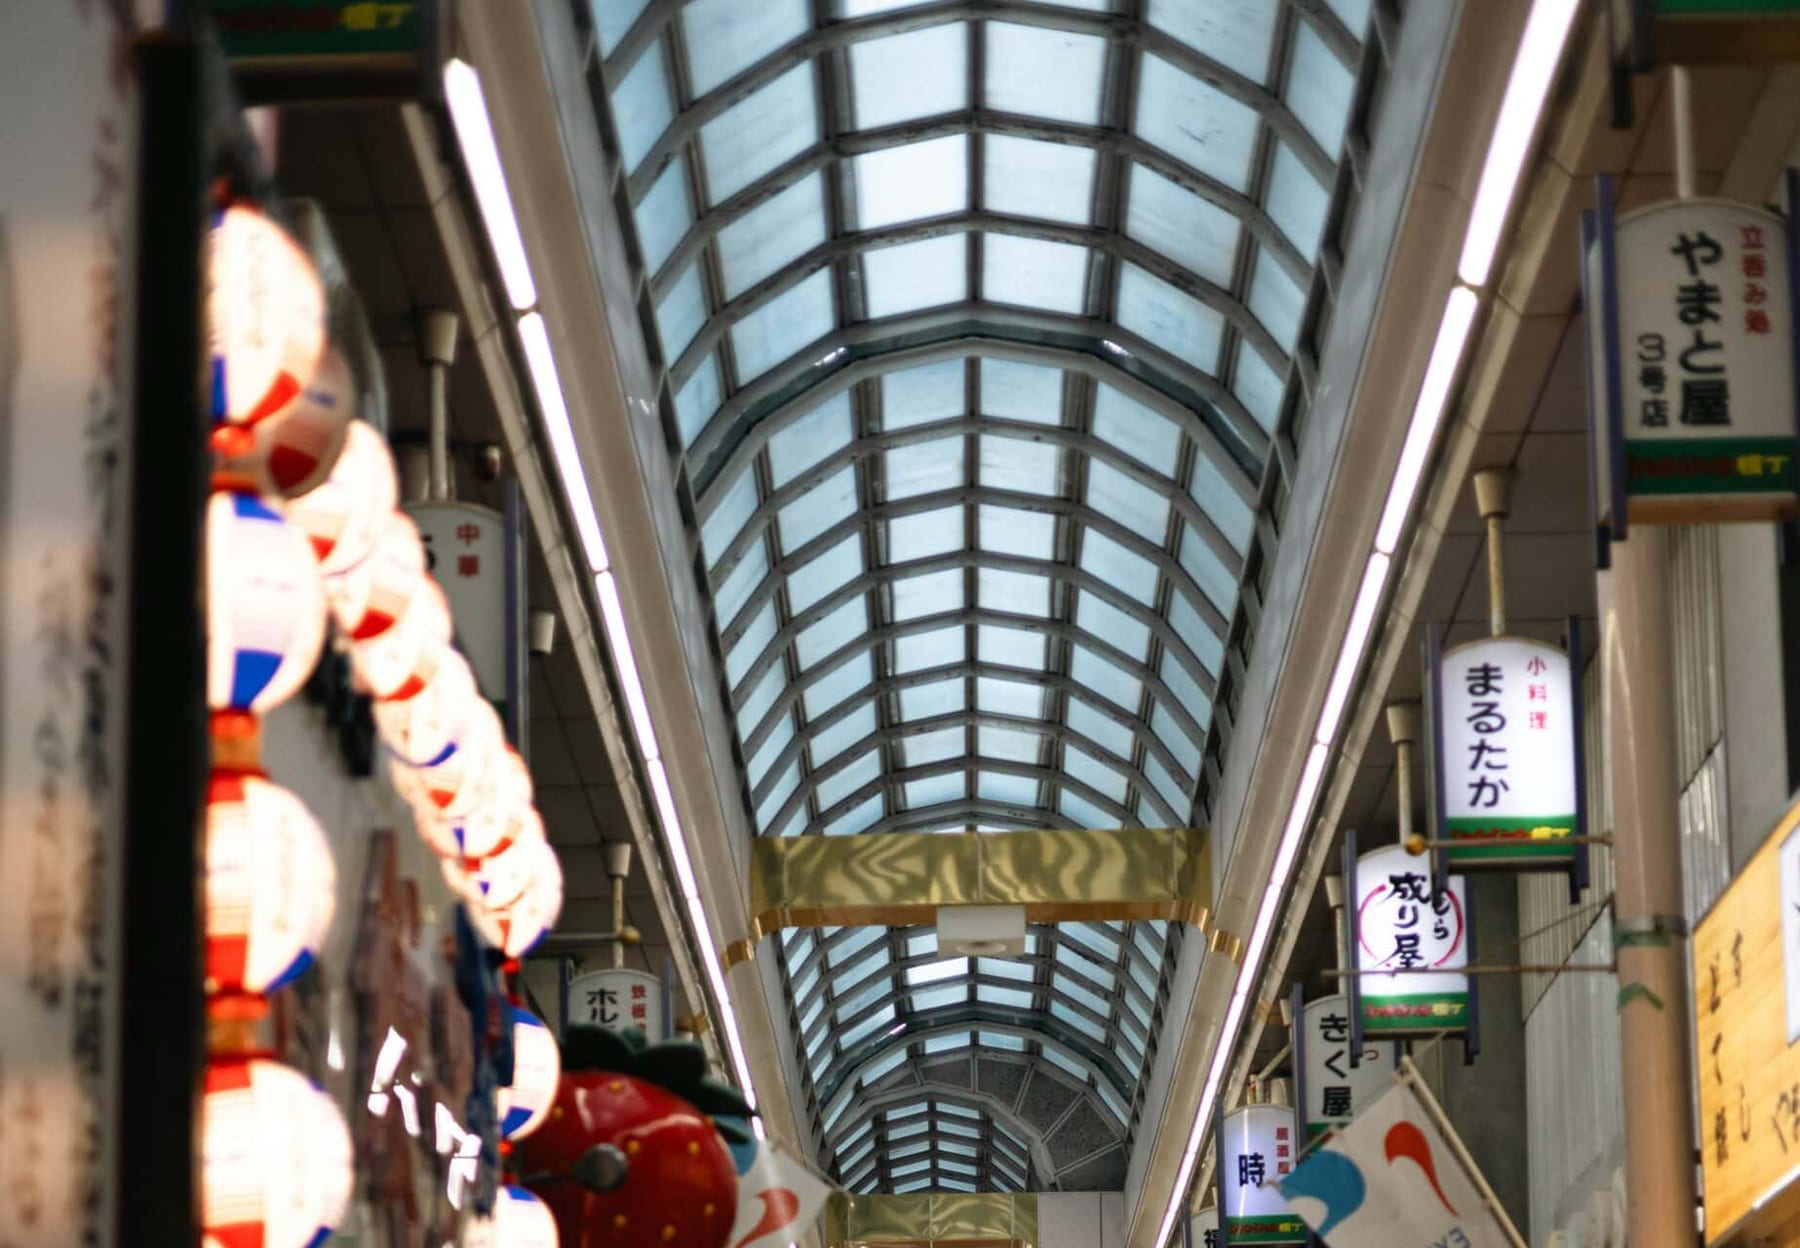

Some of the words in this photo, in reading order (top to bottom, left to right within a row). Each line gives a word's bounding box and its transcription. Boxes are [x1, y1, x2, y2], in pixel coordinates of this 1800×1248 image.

[1671, 230, 1732, 426] やまと屋
[1465, 662, 1510, 808] まるたか
[1527, 655, 1548, 730] 小料理
[585, 987, 619, 1028] ホル
[1319, 1014, 1353, 1117] きく屋
